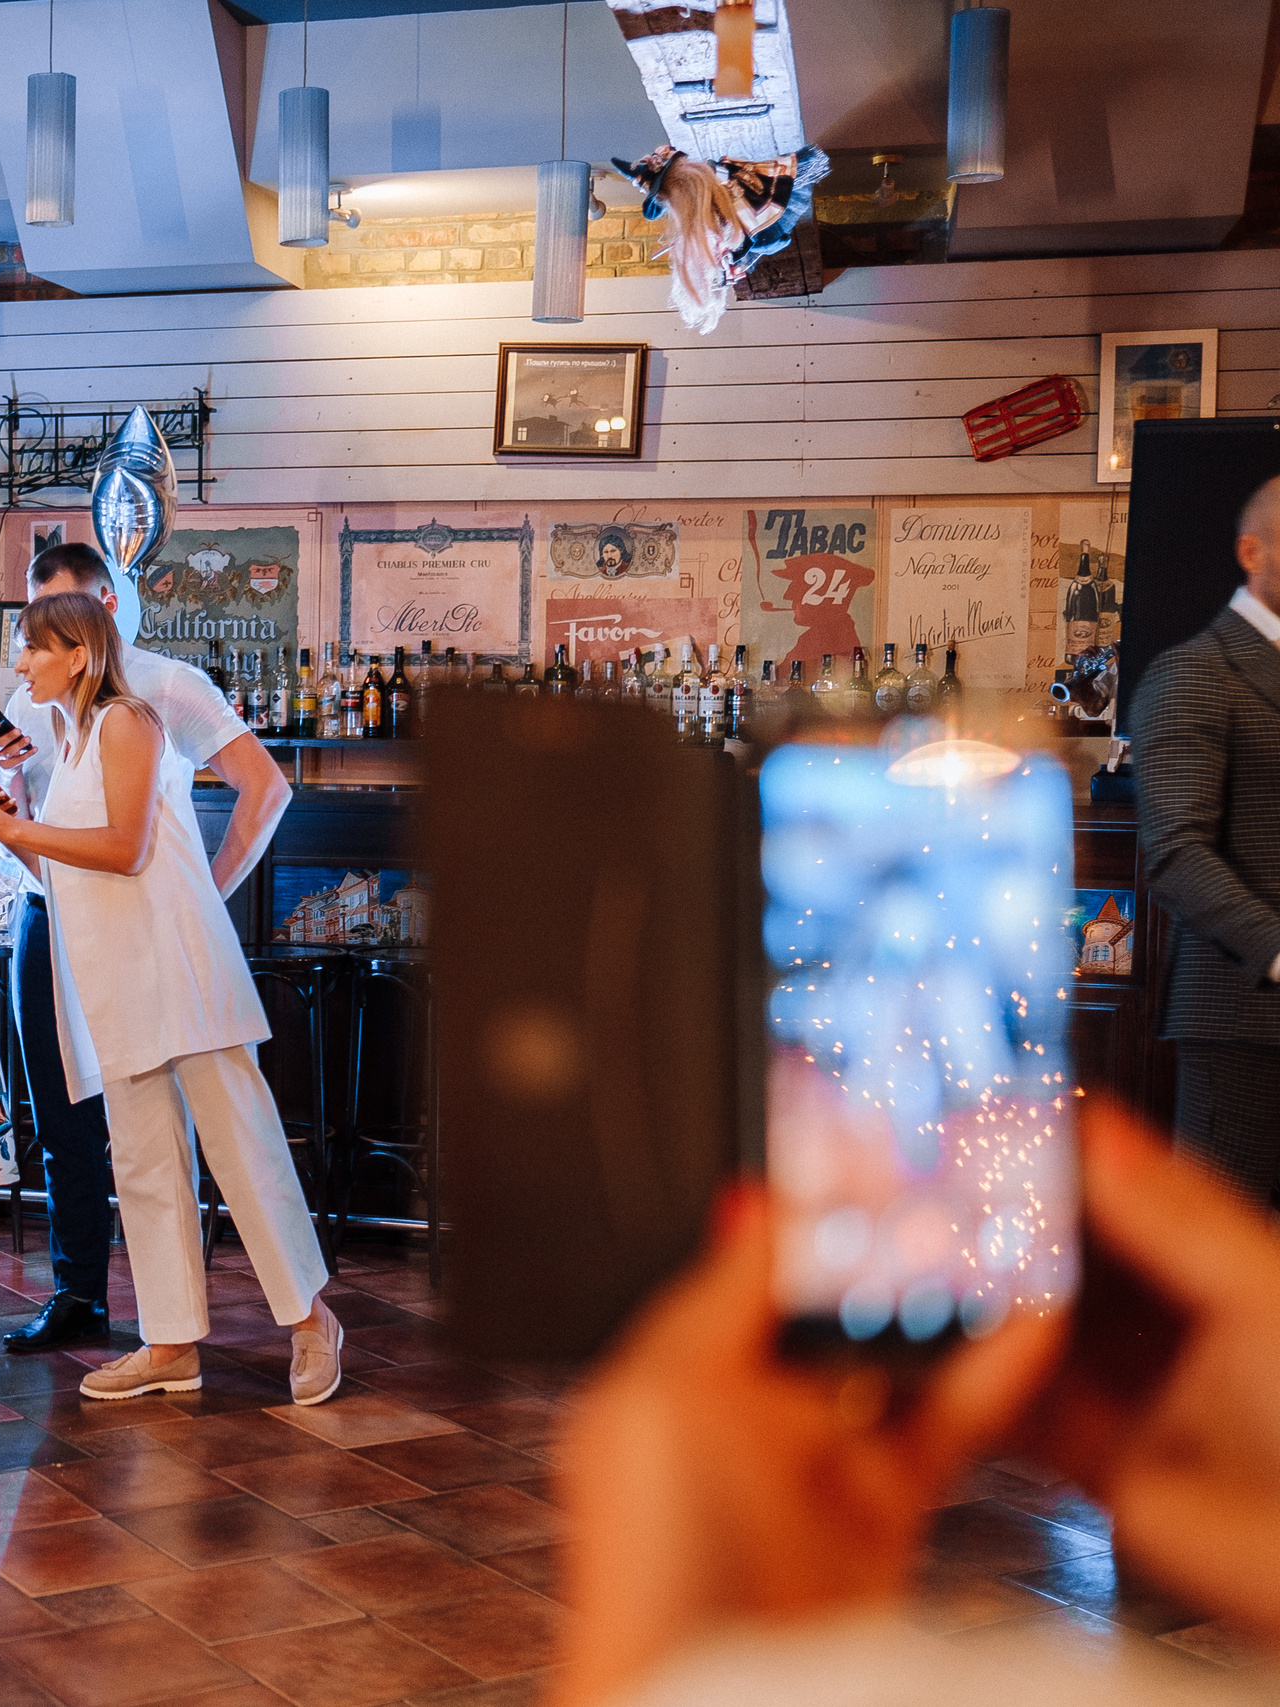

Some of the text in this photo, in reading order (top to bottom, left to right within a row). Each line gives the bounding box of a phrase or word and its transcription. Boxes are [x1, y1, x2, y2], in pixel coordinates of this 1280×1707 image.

[764, 509, 866, 559] TABAC
[894, 513, 1001, 543] Dominus
[377, 559, 491, 569] CHABLIS PREMIER CRU
[895, 552, 991, 581] Napa Valley
[801, 567, 851, 605] 24
[138, 603, 277, 640] California
[371, 600, 483, 633] Albert Pic
